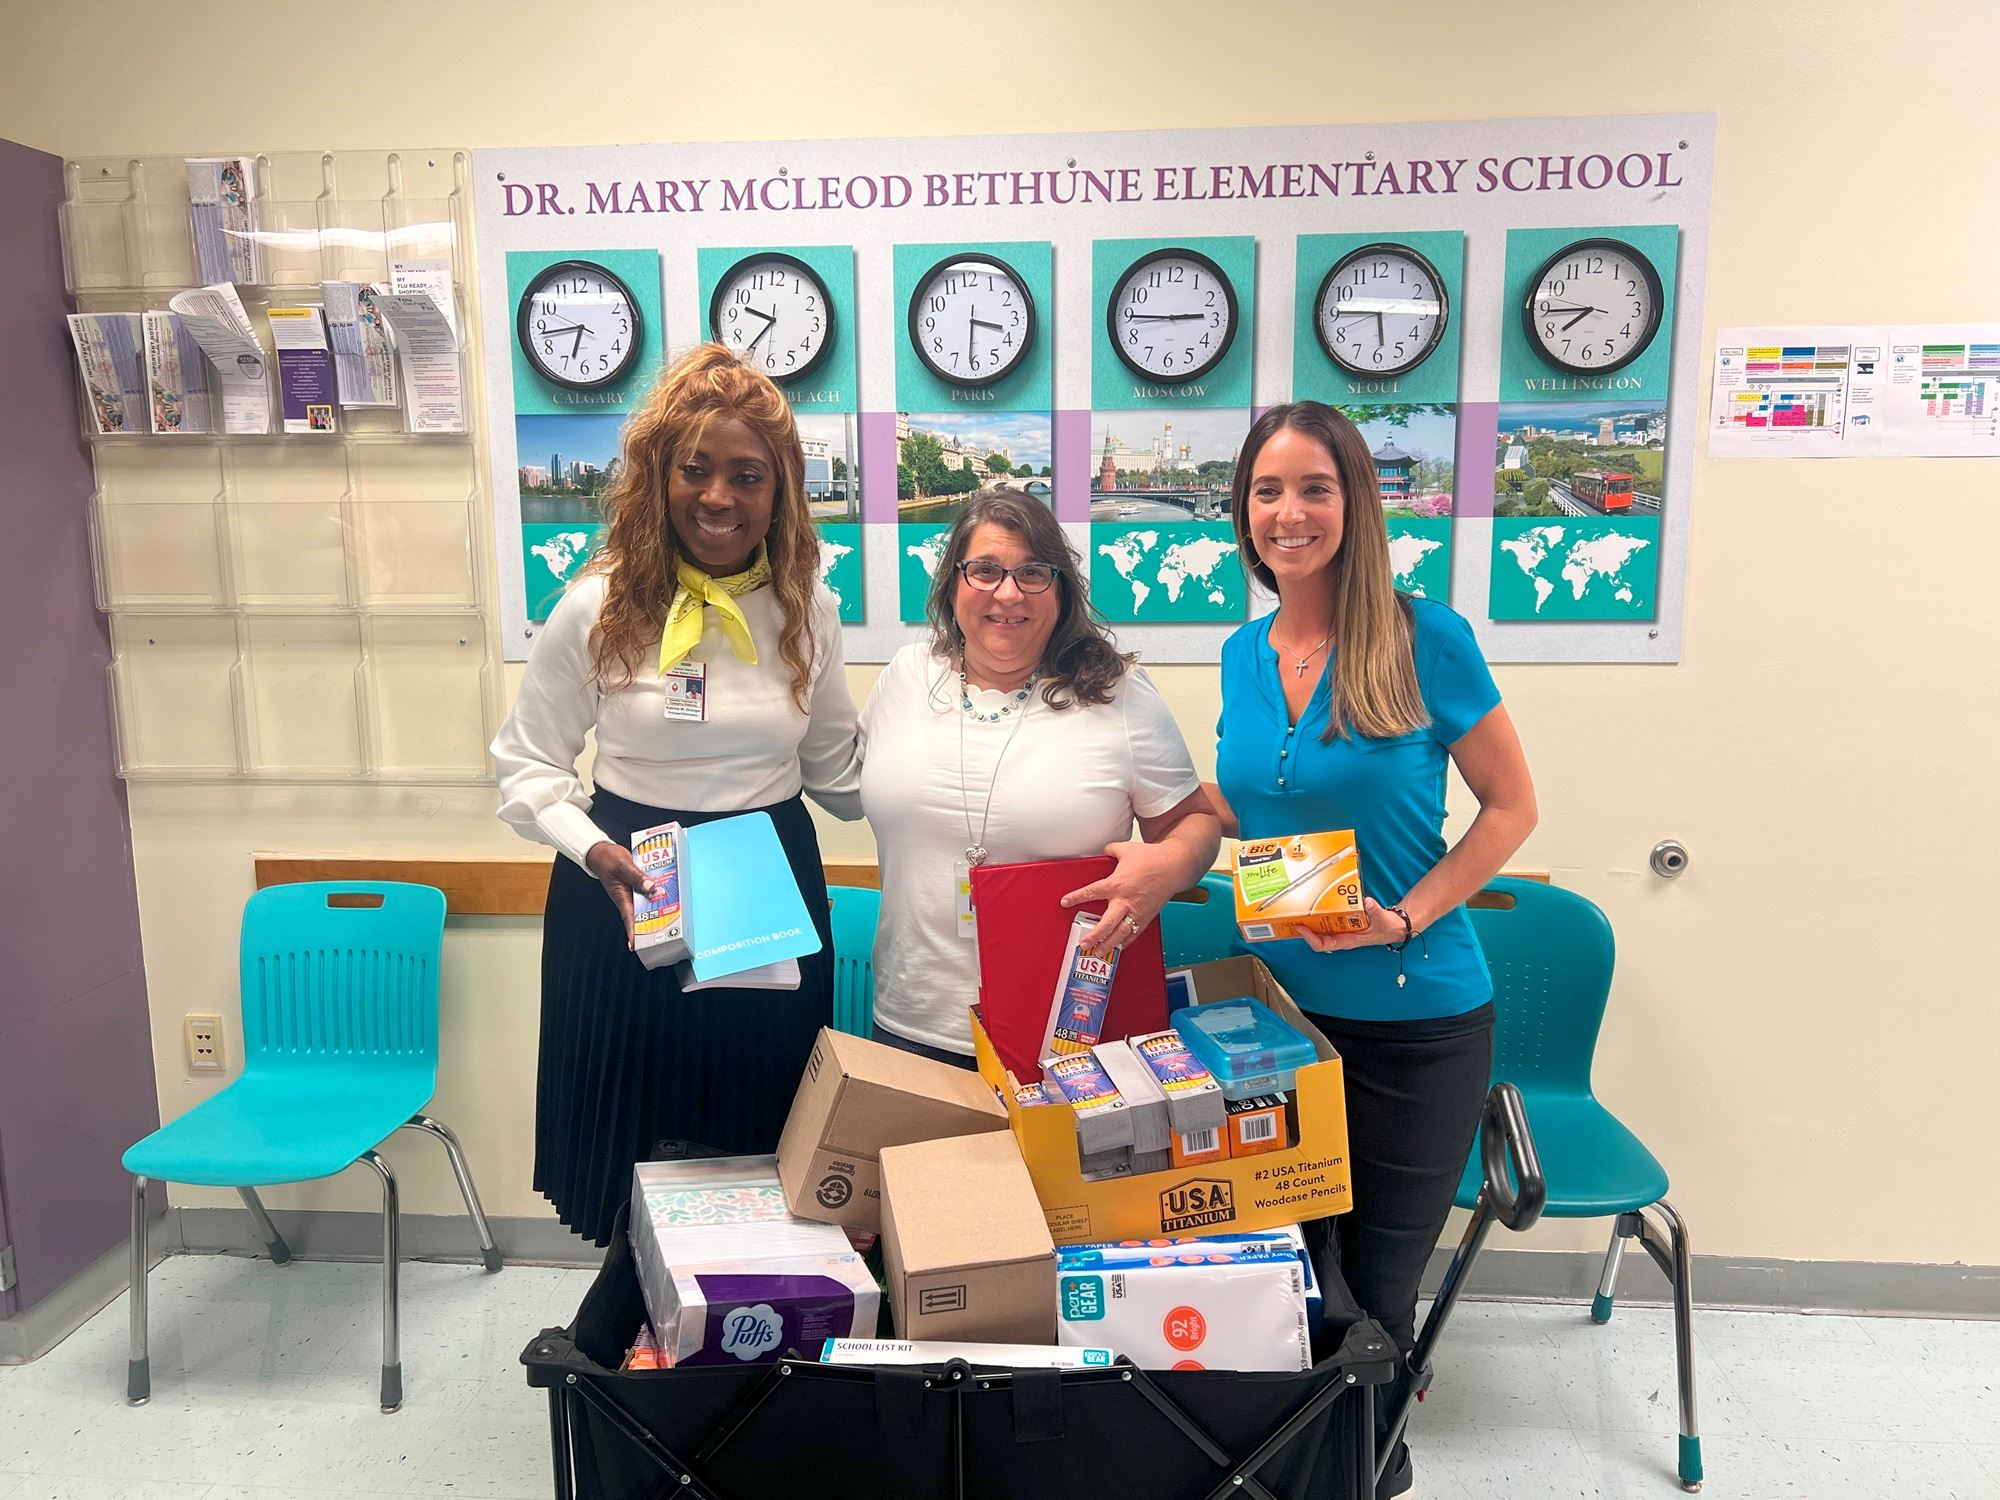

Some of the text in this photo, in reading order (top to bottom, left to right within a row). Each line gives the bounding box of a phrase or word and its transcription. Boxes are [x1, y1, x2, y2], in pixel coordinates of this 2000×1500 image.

[502, 152, 1683, 216] DR. MARY MCLEOD BETHUNE ELEMENTARY SCHOOL
[1372, 262, 1388, 278] 12
[1566, 264, 1578, 280] 11
[1586, 257, 1603, 274] 12
[1614, 264, 1619, 280] 1
[770, 271, 785, 286] 12
[962, 271, 977, 287] 12
[1149, 272, 1161, 288] 11
[1167, 266, 1183, 282] 12
[1194, 274, 1199, 290] 1
[1354, 269, 1366, 285] 11
[1400, 268, 1405, 283] 1
[572, 278, 587, 293] 12
[752, 275, 763, 290] 11
[795, 279, 799, 294] 1
[945, 279, 956, 295] 11
[988, 276, 994, 291] 1
[1549, 280, 1564, 296] 10
[1626, 280, 1636, 296] 2
[556, 284, 566, 299] 11
[598, 284, 602, 298] 1
[736, 289, 750, 304] 10
[1002, 291, 1011, 306] 2
[1131, 287, 1147, 303] 10
[1205, 291, 1214, 307] 2
[1337, 285, 1353, 302] 10
[1413, 284, 1422, 299] 2
[542, 300, 556, 315] 10
[611, 300, 620, 314] 2
[806, 296, 814, 312] 2
[930, 296, 945, 312] 10
[1540, 301, 1550, 317] 9
[1632, 302, 1641, 318] 3
[729, 308, 737, 323] 9
[1011, 311, 1019, 326] 3
[1125, 307, 1134, 323] 9
[1210, 312, 1219, 328] 3
[1330, 306, 1339, 323] 9
[537, 320, 546, 335] 9
[619, 318, 627, 334] 3
[811, 317, 819, 332] 3
[926, 317, 935, 333] 9
[1545, 322, 1554, 338] 8
[1620, 322, 1630, 338] 4
[733, 328, 742, 343] 8
[1003, 332, 1012, 347] 4
[1129, 328, 1138, 344] 8
[1200, 332, 1209, 348] 4
[1336, 327, 1345, 343] 8
[1409, 325, 1419, 341] 4
[545, 339, 553, 355] 8
[611, 339, 621, 354] 4
[801, 336, 810, 351] 4
[934, 337, 942, 353] 8
[1352, 344, 1361, 359] 7
[1394, 342, 1404, 358] 5
[1561, 340, 1570, 355] 7
[1603, 339, 1614, 355] 5
[786, 351, 795, 366] 5
[950, 352, 958, 368] 7
[990, 349, 999, 365] 5
[1144, 346, 1153, 362] 7
[1164, 352, 1173, 367] 6
[1184, 348, 1194, 364] 5
[1373, 347, 1382, 363] 6
[1582, 344, 1592, 360] 6
[561, 356, 568, 370] 7
[580, 360, 589, 375] 6
[600, 355, 608, 370] 5
[766, 353, 775, 368] 6
[970, 355, 979, 371] 6
[1134, 385, 1208, 398] MOSCOW
[1348, 381, 1401, 394] SEOUL
[1525, 377, 1642, 390] WELLINGTON
[553, 392, 624, 404] CALGARY
[788, 390, 840, 402] BEACH
[952, 389, 995, 400] PARIS
[642, 849, 669, 864] USA
[1337, 884, 1357, 895] 60
[635, 913, 649, 922] 48
[695, 928, 802, 960] COMPOSITION BOOK
[1080, 959, 1106, 975] USA
[1074, 972, 1106, 985] TITANIUM
[1056, 1028, 1068, 1038] 48
[1148, 1043, 1178, 1052] USA
[1060, 1064, 1090, 1074] USA
[1255, 1157, 1342, 1180] #2 USA Titanium
[1276, 1174, 1325, 1190] 48 Count
[1255, 1184, 1346, 1208] Woodcase Pencils
[1163, 1210, 1230, 1231] TITANIUM
[1080, 1282, 1098, 1314] GEAR
[729, 1315, 774, 1348] Puffs
[1172, 1320, 1188, 1338] 92
[1189, 1316, 1200, 1340] Bright
